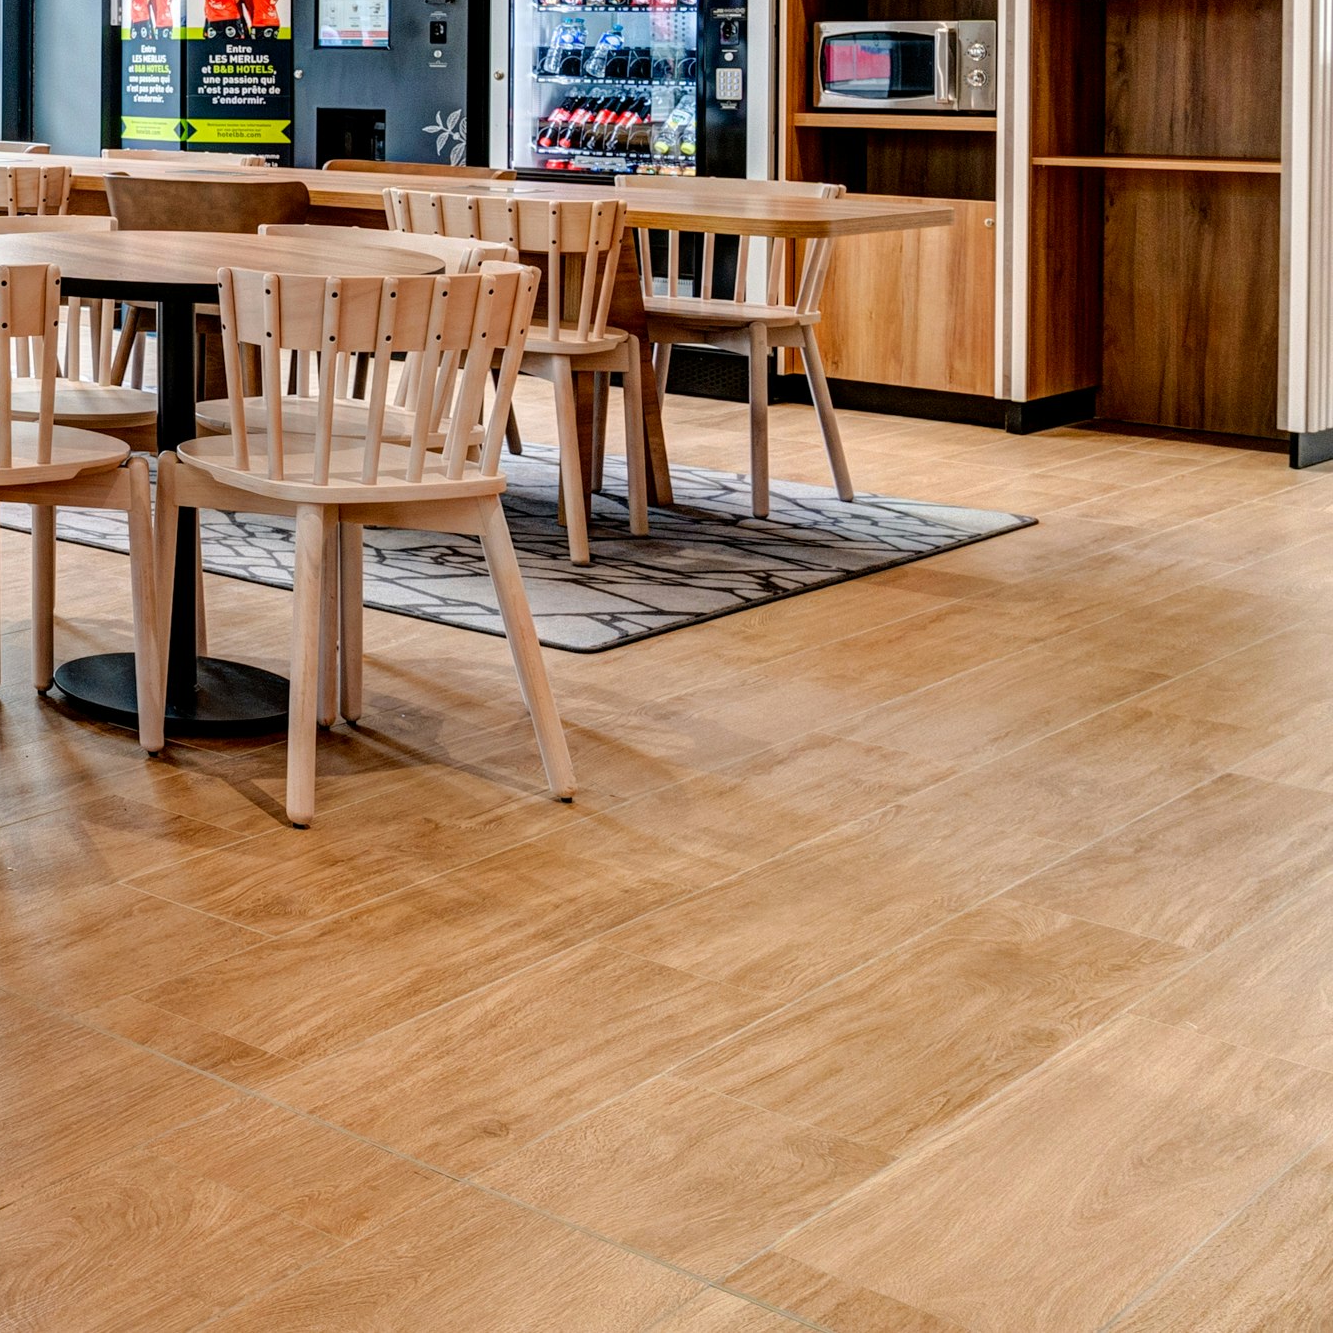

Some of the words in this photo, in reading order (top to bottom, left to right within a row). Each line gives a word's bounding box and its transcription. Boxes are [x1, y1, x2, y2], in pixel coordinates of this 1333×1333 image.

[226, 44, 252, 53] Entre
[209, 55, 227, 63] LES
[229, 55, 269, 63] MERLUS
[201, 65, 211, 74] et
[213, 65, 234, 74] B&B
[236, 65, 277, 75] HOTELS,
[222, 75, 259, 85] passion
[260, 75, 275, 86] qui
[197, 86, 221, 94] n'est
[223, 87, 240, 96] pas
[241, 85, 267, 96] prête
[269, 86, 281, 94] de
[212, 96, 266, 104] s'endormir.
